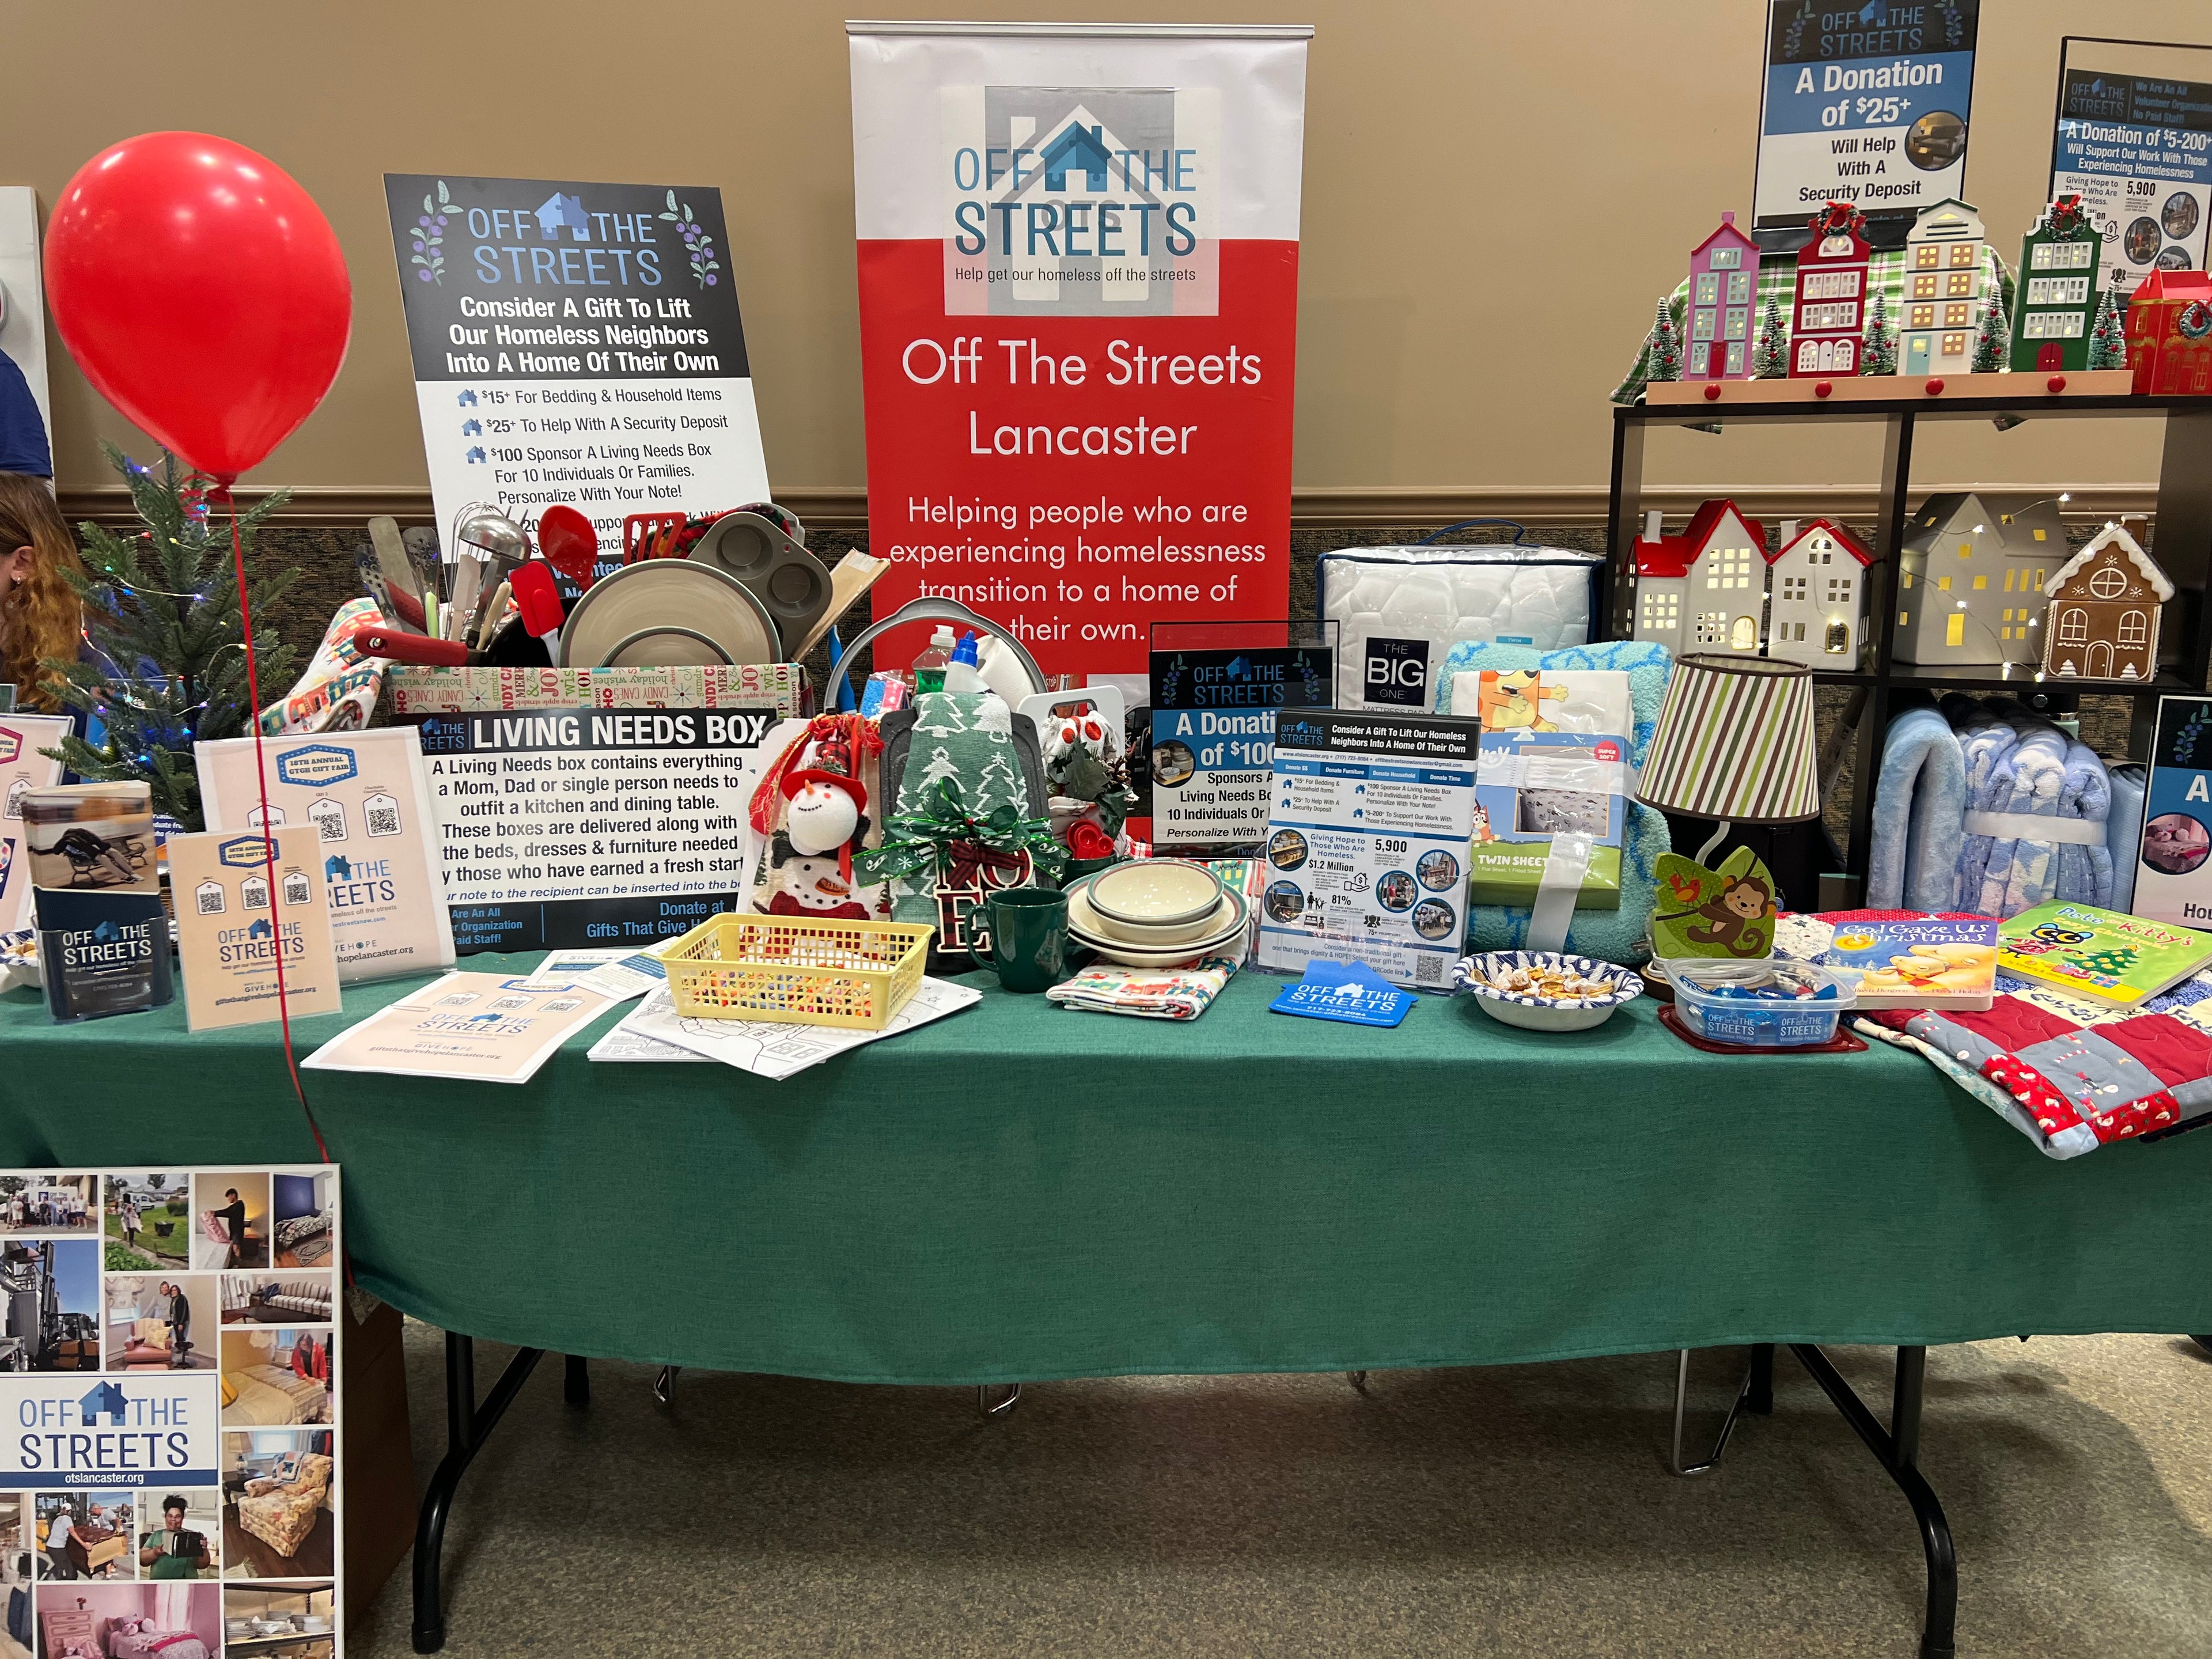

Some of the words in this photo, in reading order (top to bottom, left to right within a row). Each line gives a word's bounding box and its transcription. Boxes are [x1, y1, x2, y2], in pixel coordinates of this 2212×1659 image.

[1822, 12, 1856, 31] OFF
[1889, 6, 1924, 25] THE
[1820, 28, 1922, 56] STREETS
[1795, 68, 1814, 93] A
[1824, 60, 1942, 92] Donation
[2071, 83, 2090, 96] OFF
[2108, 86, 2125, 100] THE
[1822, 100, 1849, 126] of
[1857, 97, 1911, 123] $25+
[2070, 97, 2124, 116] STREETS
[2066, 122, 2077, 139] A
[2082, 122, 2141, 146] Donation
[2146, 130, 2161, 146] of
[1832, 139, 1858, 154] Will
[1863, 137, 1895, 153] Help
[2068, 143, 2084, 154] Will
[2086, 145, 2119, 158] Support
[2122, 148, 2137, 159] Our
[2139, 150, 2160, 161] Work
[2163, 152, 2181, 164] With
[2184, 154, 2207, 166] Those
[954, 148, 1035, 192] OFF
[1115, 149, 1196, 191] THE
[1838, 161, 1870, 176] With
[1875, 160, 1885, 173] A
[2078, 158, 2133, 175] Experiencing
[2135, 166, 2194, 179] Homelessness
[1800, 185, 1860, 203] Security
[1865, 180, 1921, 199] Deposit
[2127, 181, 2156, 196] 5,900
[468, 208, 531, 239] OFF
[591, 213, 656, 243] THE
[956, 202, 1195, 256] STREETS
[474, 246, 661, 285] STREETS
[956, 267, 982, 282] Help
[988, 269, 1007, 283] get
[1013, 271, 1033, 280] our
[1039, 268, 1100, 281] homeless
[1106, 268, 1122, 281] off
[1127, 268, 1145, 281] the
[1151, 269, 1195, 281] streets
[461, 297, 555, 317] Consider
[563, 298, 579, 317] A
[585, 298, 623, 317] Gift
[626, 298, 651, 317] To
[657, 298, 691, 317] Lift
[450, 324, 488, 344] Our
[495, 325, 600, 344] Homeless
[605, 325, 709, 349] Neighbors
[446, 353, 490, 372] Into
[498, 353, 514, 372] A
[518, 353, 580, 372] Home
[587, 352, 609, 372] Of
[615, 351, 667, 371] Their
[674, 351, 719, 370] Own
[903, 337, 982, 384] Off
[998, 338, 1086, 385] The
[1107, 340, 1260, 385] Streets
[482, 390, 510, 403] $15+
[516, 391, 537, 403] For
[542, 390, 596, 405] Bedding
[601, 389, 611, 402] &
[615, 388, 683, 402] Household
[687, 389, 721, 400] Items
[971, 411, 1197, 455] Lancaster
[910, 496, 1016, 529] Helping
[1030, 496, 1123, 529] people
[1133, 496, 1191, 522] who
[1203, 505, 1247, 522] are
[891, 537, 1065, 569] experiencing
[1078, 536, 1265, 562] homelessness
[1384, 643, 1408, 654] THE
[630, 675, 668, 685] holiday
[1194, 667, 1224, 682] OFF
[1253, 665, 1284, 680] THE
[1368, 657, 1424, 686] BIG
[593, 677, 627, 686] wishes
[1046, 678, 1056, 687] STOP
[614, 687, 639, 700] CANES
[643, 687, 668, 699] CANDY
[1195, 683, 1285, 704] STREETS
[1380, 689, 1404, 699] ONE
[475, 717, 579, 748] LIVING
[592, 715, 695, 744] NEEDS
[706, 715, 767, 743] BOX
[1176, 713, 1193, 735] A
[1201, 712, 1277, 735] Donati
[1308, 726, 1324, 736] THE
[1332, 725, 1365, 734] Consider
[1373, 727, 1387, 736] Gift
[1388, 728, 1397, 736] To
[1399, 729, 1412, 737] Lift
[1414, 730, 1427, 738] Our
[1429, 730, 1466, 740] Homeless
[1281, 733, 1323, 745] STREETS
[1201, 743, 1224, 766] of
[433, 761, 444, 774] A
[450, 759, 496, 775] Living
[503, 757, 551, 771] Needs
[558, 756, 585, 770] box
[592, 755, 657, 769] contains
[663, 754, 742, 771] everything
[439, 785, 447, 796] a
[454, 781, 498, 796] Mom,
[505, 778, 535, 793] Dad
[541, 781, 557, 791] or
[563, 777, 609, 794] single
[615, 778, 667, 793] person
[674, 775, 718, 789] needs
[724, 775, 738, 787] to
[1208, 772, 1262, 786] Sponsors
[1376, 839, 1407, 853] 5,900
[353, 859, 391, 878] THE
[1309, 859, 1324, 869] $1.2
[1327, 861, 1353, 872] Million
[1478, 855, 1510, 865] TWIN
[660, 902, 707, 915] Donate
[712, 900, 724, 912] at
[1332, 895, 1351, 905] 81%
[63, 930, 92, 948] OFF
[120, 924, 150, 939] THE
[218, 929, 248, 945] OFF
[1842, 924, 1885, 934] God
[1889, 923, 1951, 934] Gave
[1956, 925, 1989, 933] Us
[1853, 932, 1987, 942] Christmas
[2056, 907, 2105, 925] Pete
[2116, 922, 2195, 948] Kitty's
[65, 938, 152, 965] STREETS
[1291, 992, 1396, 1012] STREETS
[1298, 985, 1333, 996] OFF
[1366, 990, 1400, 1002] THE
[417, 1019, 529, 1033] STREETS
[432, 1013, 470, 1021] OFF
[1708, 1013, 1724, 1022] OFF
[1738, 1017, 1755, 1026] THE
[1707, 1022, 1755, 1036] STREETS
[20, 1400, 74, 1427] OFF
[131, 1398, 187, 1426] THE
[21, 1433, 188, 1469] STREETS
[65, 1473, 143, 1484] otslancaster.org
